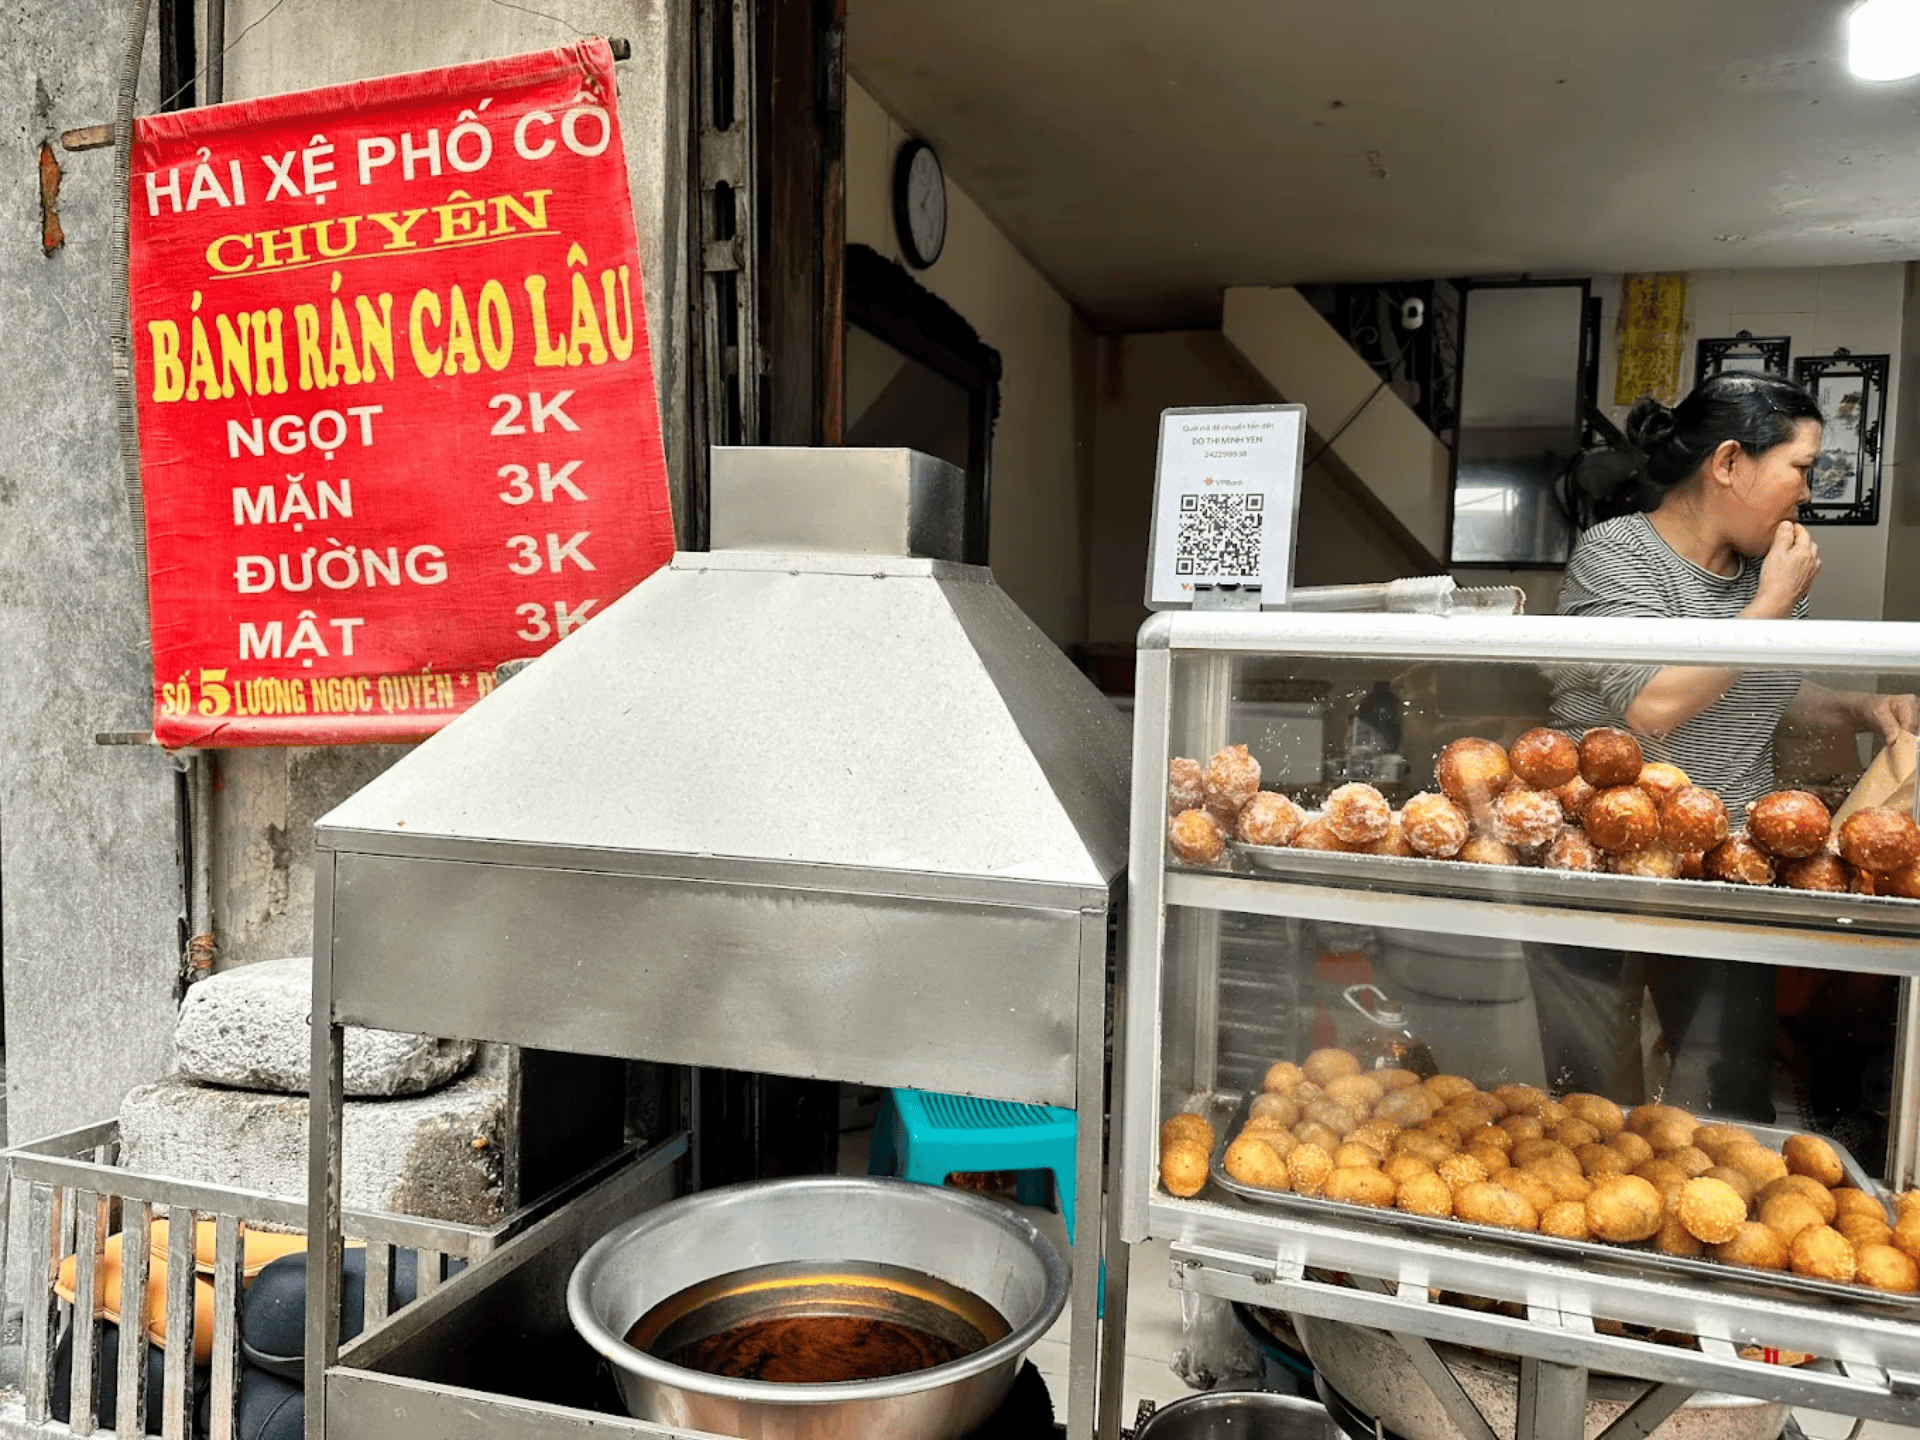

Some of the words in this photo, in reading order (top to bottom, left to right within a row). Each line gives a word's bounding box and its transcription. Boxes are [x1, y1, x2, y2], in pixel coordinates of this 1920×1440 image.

[146, 147, 246, 217] HẢI
[261, 134, 338, 206] XỆ
[357, 98, 493, 185] PHỐ
[205, 189, 553, 272] CHUYÊN
[148, 290, 289, 402] BÁNH
[293, 270, 395, 390] RÁN
[409, 279, 514, 379] CAO
[524, 241, 635, 368] LÂU
[226, 405, 384, 461] NGỌT
[488, 389, 582, 437] 2K
[1192, 437, 1205, 445] DO
[1206, 436, 1220, 445] THI
[1221, 436, 1244, 445] MINH
[1246, 435, 1263, 444] YEN
[232, 472, 354, 532] MẶN
[497, 460, 589, 506] 3K
[233, 537, 449, 594] ĐƯỜNG
[506, 531, 597, 576] 3K
[239, 609, 365, 668] MẬT
[515, 599, 599, 642] 3K
[160, 669, 191, 717] SỐ
[197, 667, 232, 718] 5
